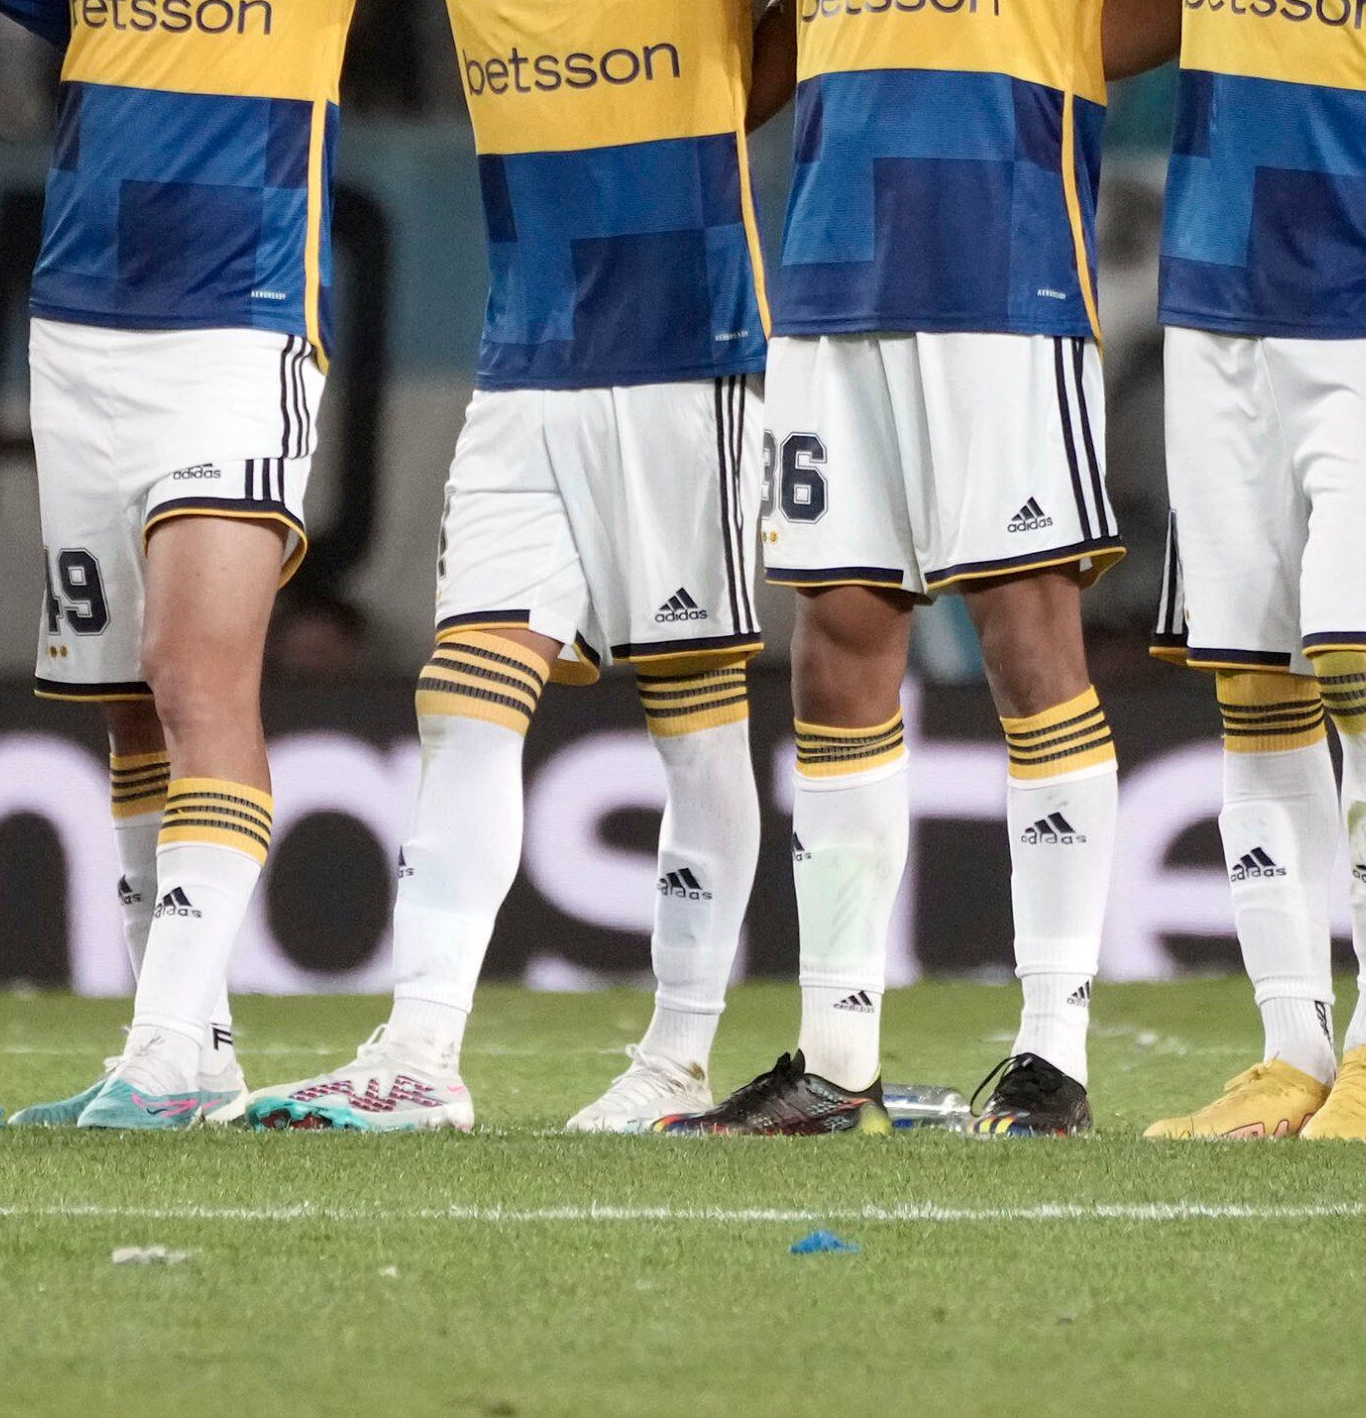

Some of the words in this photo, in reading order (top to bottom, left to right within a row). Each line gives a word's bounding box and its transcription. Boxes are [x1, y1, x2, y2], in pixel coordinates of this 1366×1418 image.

[461, 42, 682, 97] betsson
[172, 465, 222, 481] adidas
[1006, 516, 1055, 533] adidas
[653, 605, 709, 623] adidas
[1020, 832, 1088, 845] adidas
[1230, 866, 1287, 883] adidas
